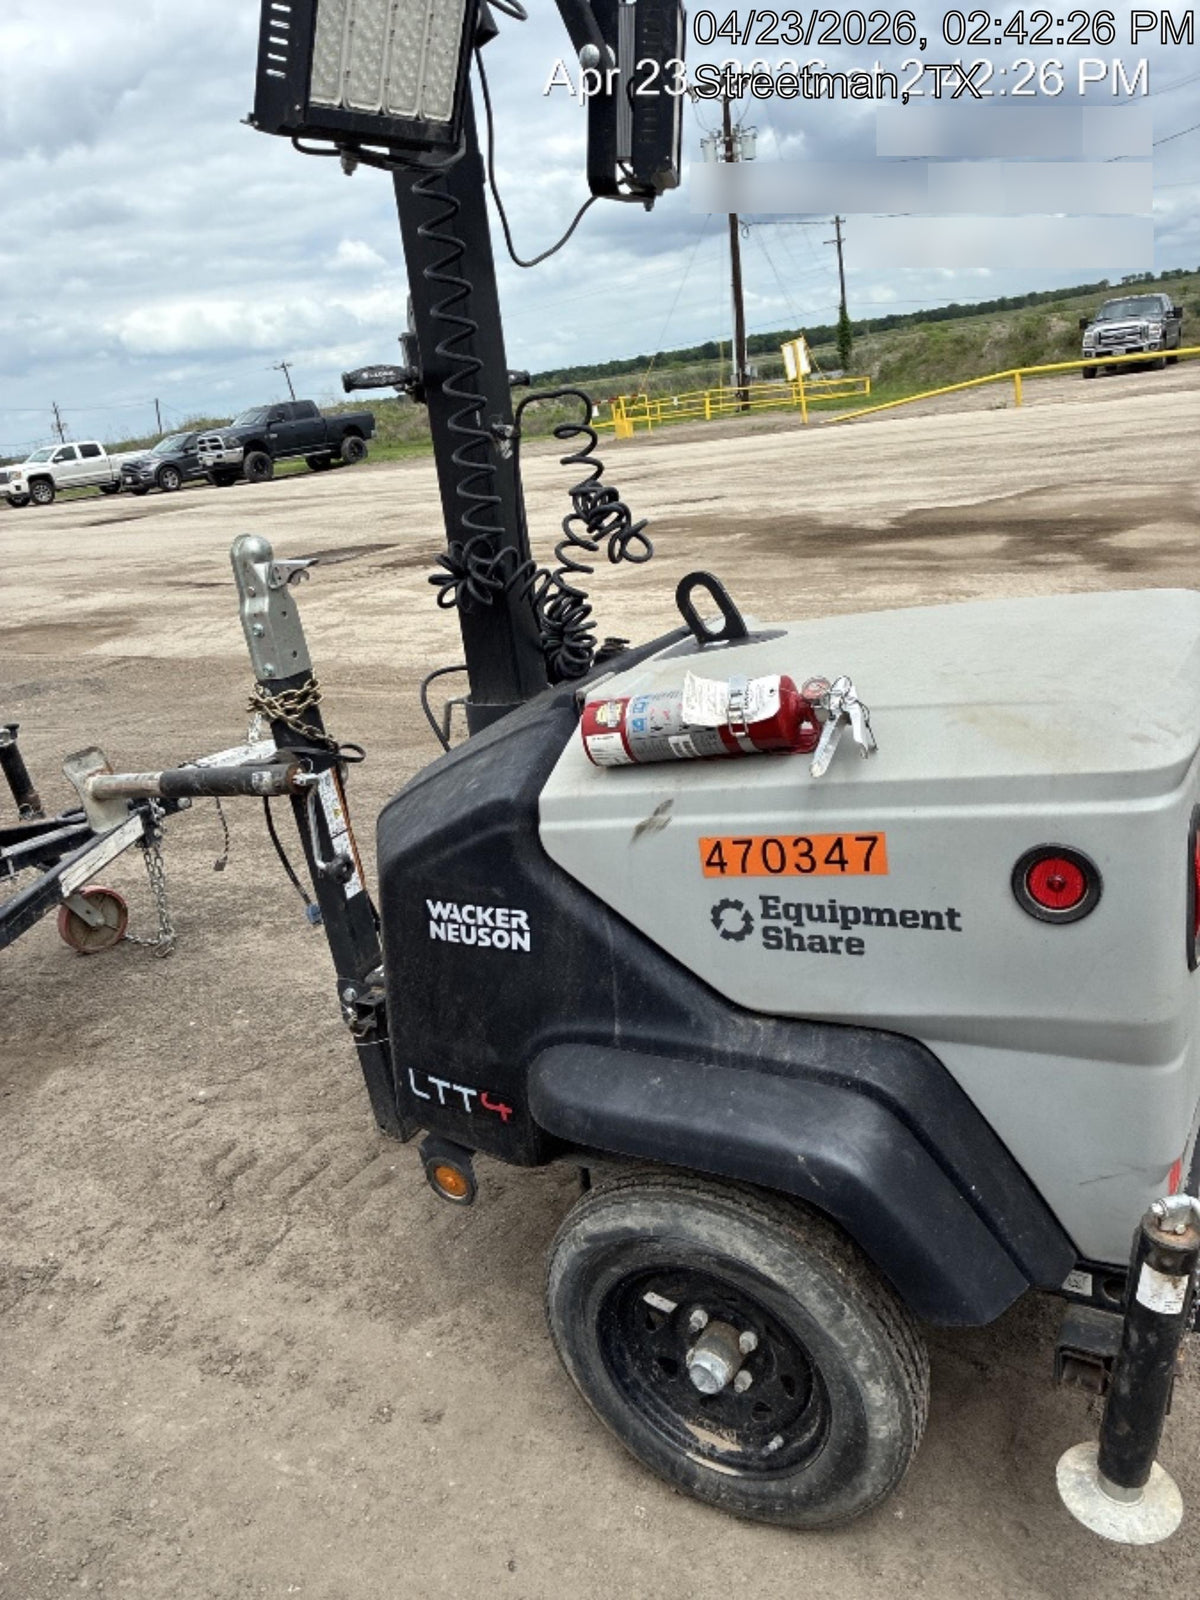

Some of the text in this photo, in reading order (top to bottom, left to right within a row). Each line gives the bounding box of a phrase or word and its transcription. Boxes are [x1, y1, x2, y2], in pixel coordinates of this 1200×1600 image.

[704, 835, 880, 874] 470347
[425, 899, 530, 930] WACKER
[759, 895, 963, 932] Equipment
[429, 921, 532, 952] NEUSON
[762, 927, 866, 956] Share
[408, 1067, 513, 1122] LTT4
